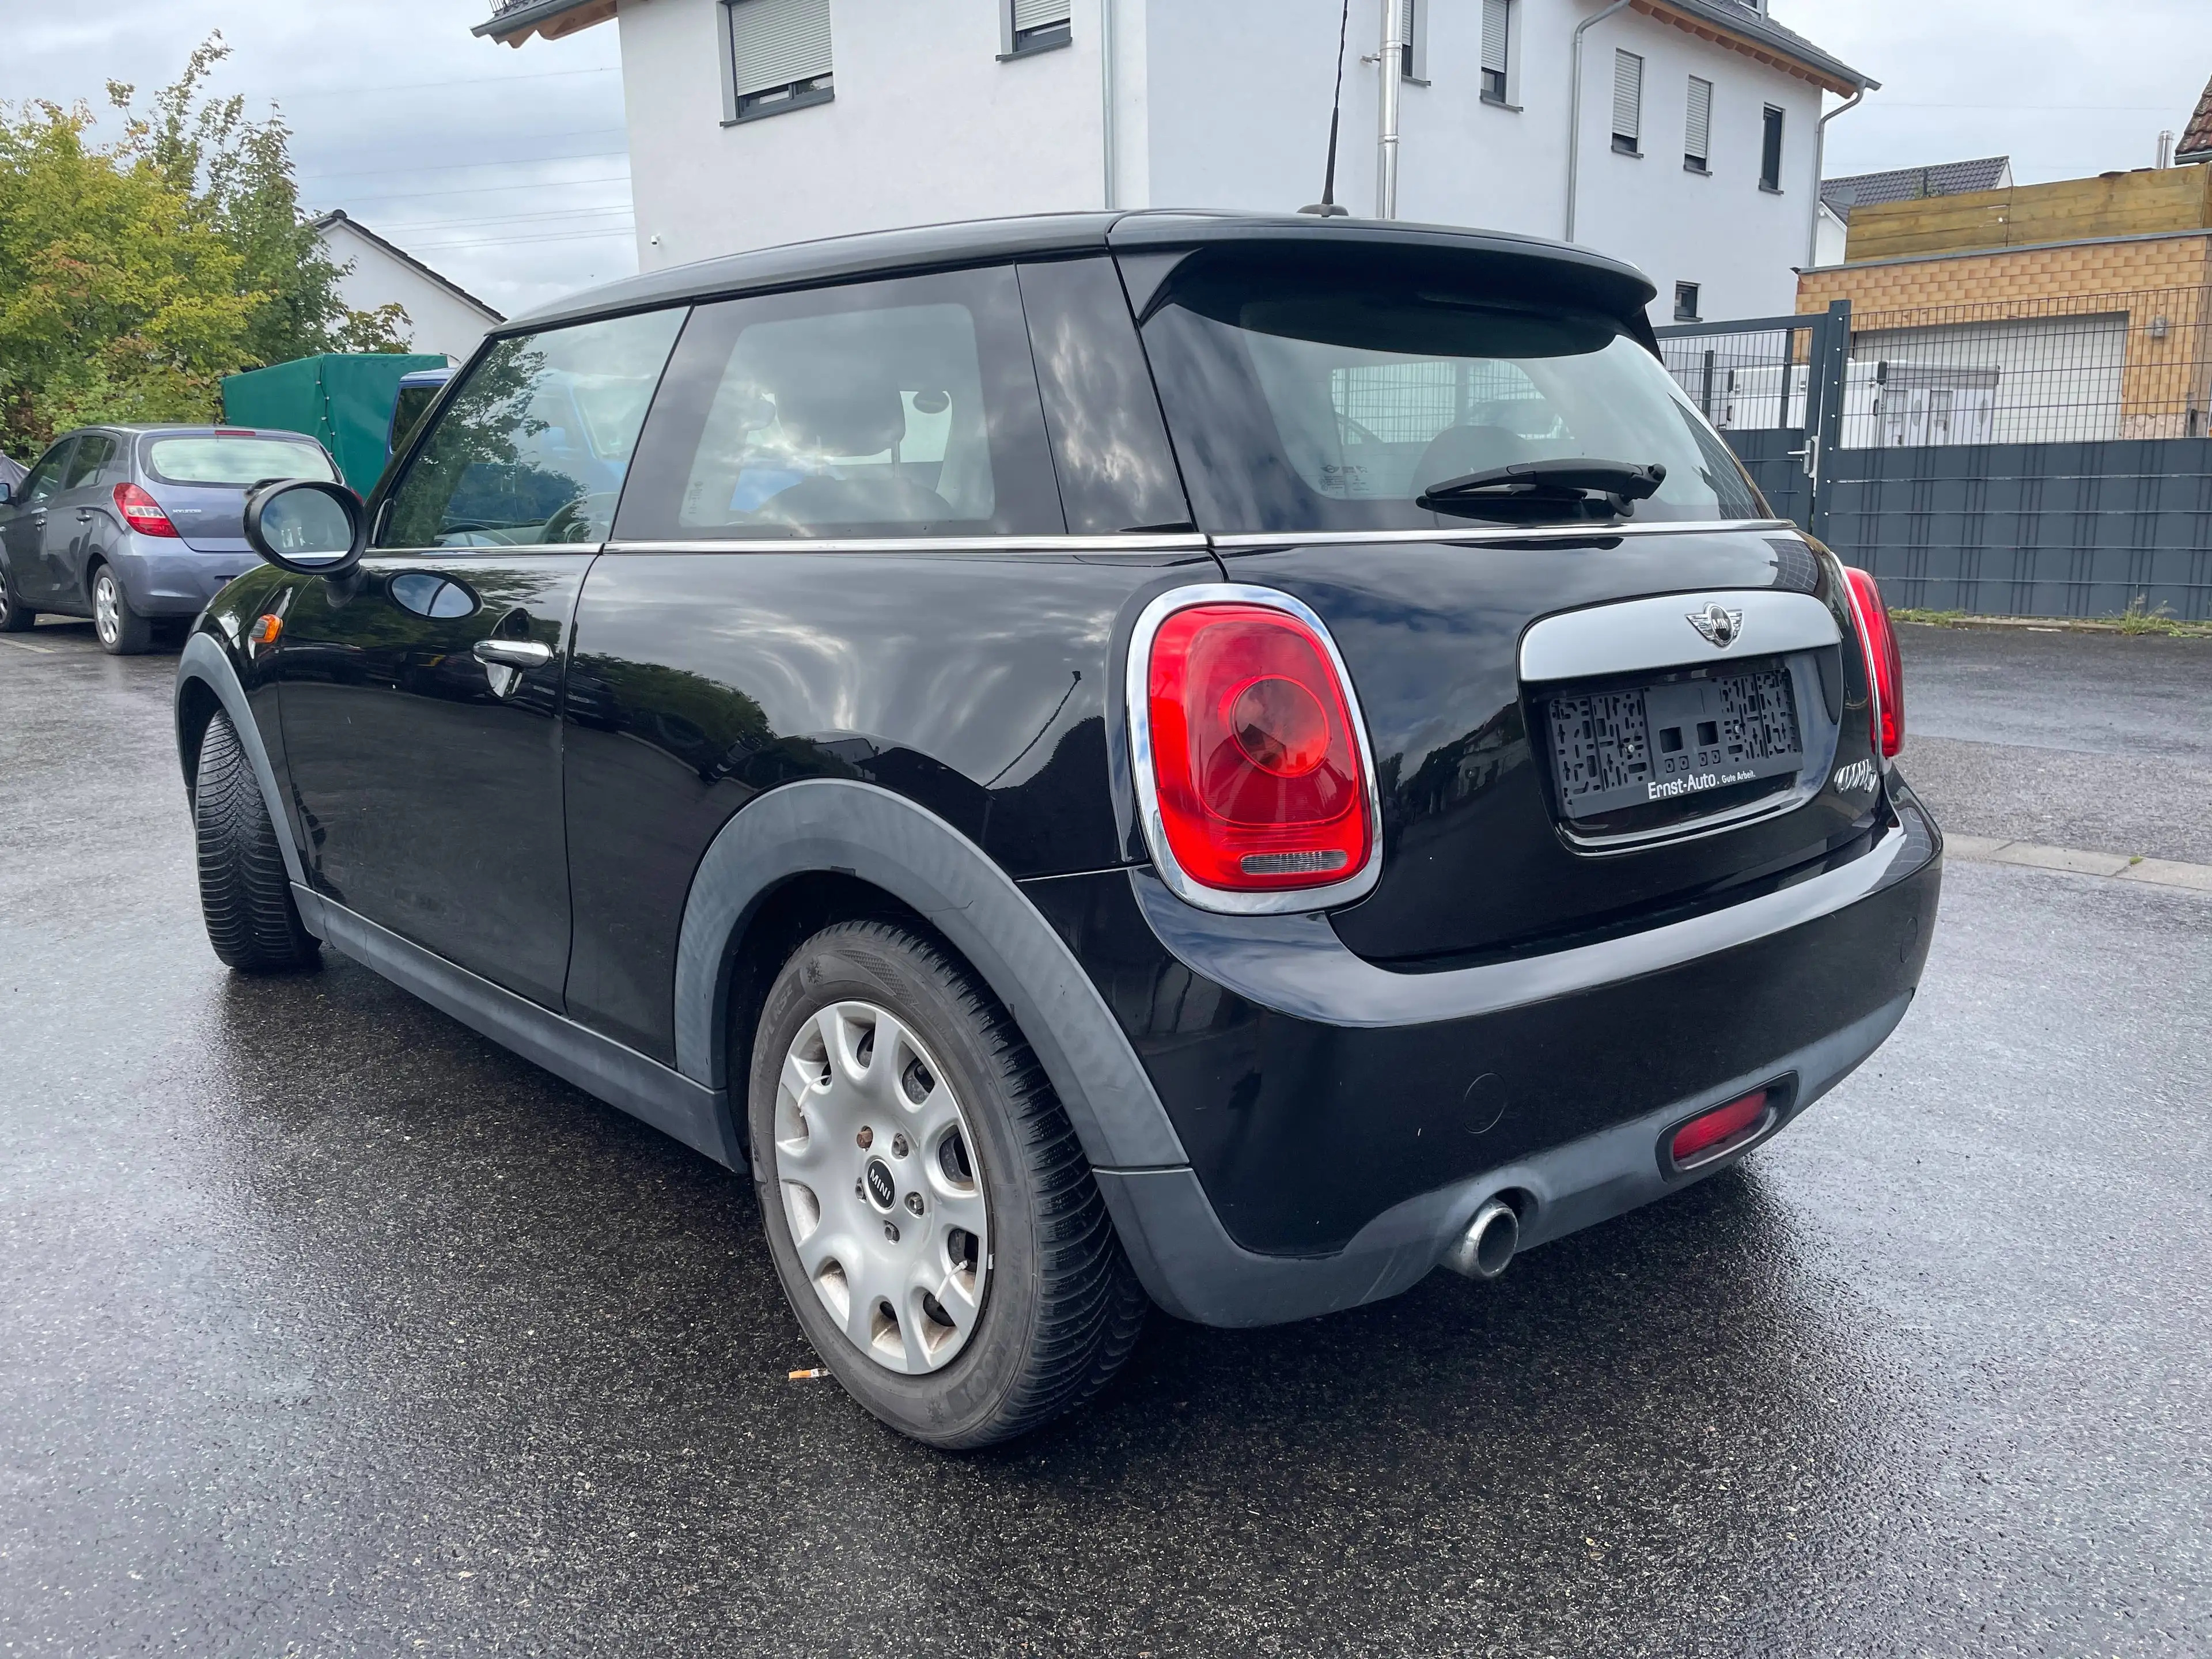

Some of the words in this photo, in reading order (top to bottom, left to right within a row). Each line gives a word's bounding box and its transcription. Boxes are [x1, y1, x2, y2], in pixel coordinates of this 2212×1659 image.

[1647, 772, 1719, 800] Ernst-Auto.
[1721, 774, 1736, 784] Gute
[1737, 770, 1756, 781] Arbeit.
[870, 1168, 891, 1200] MINI
